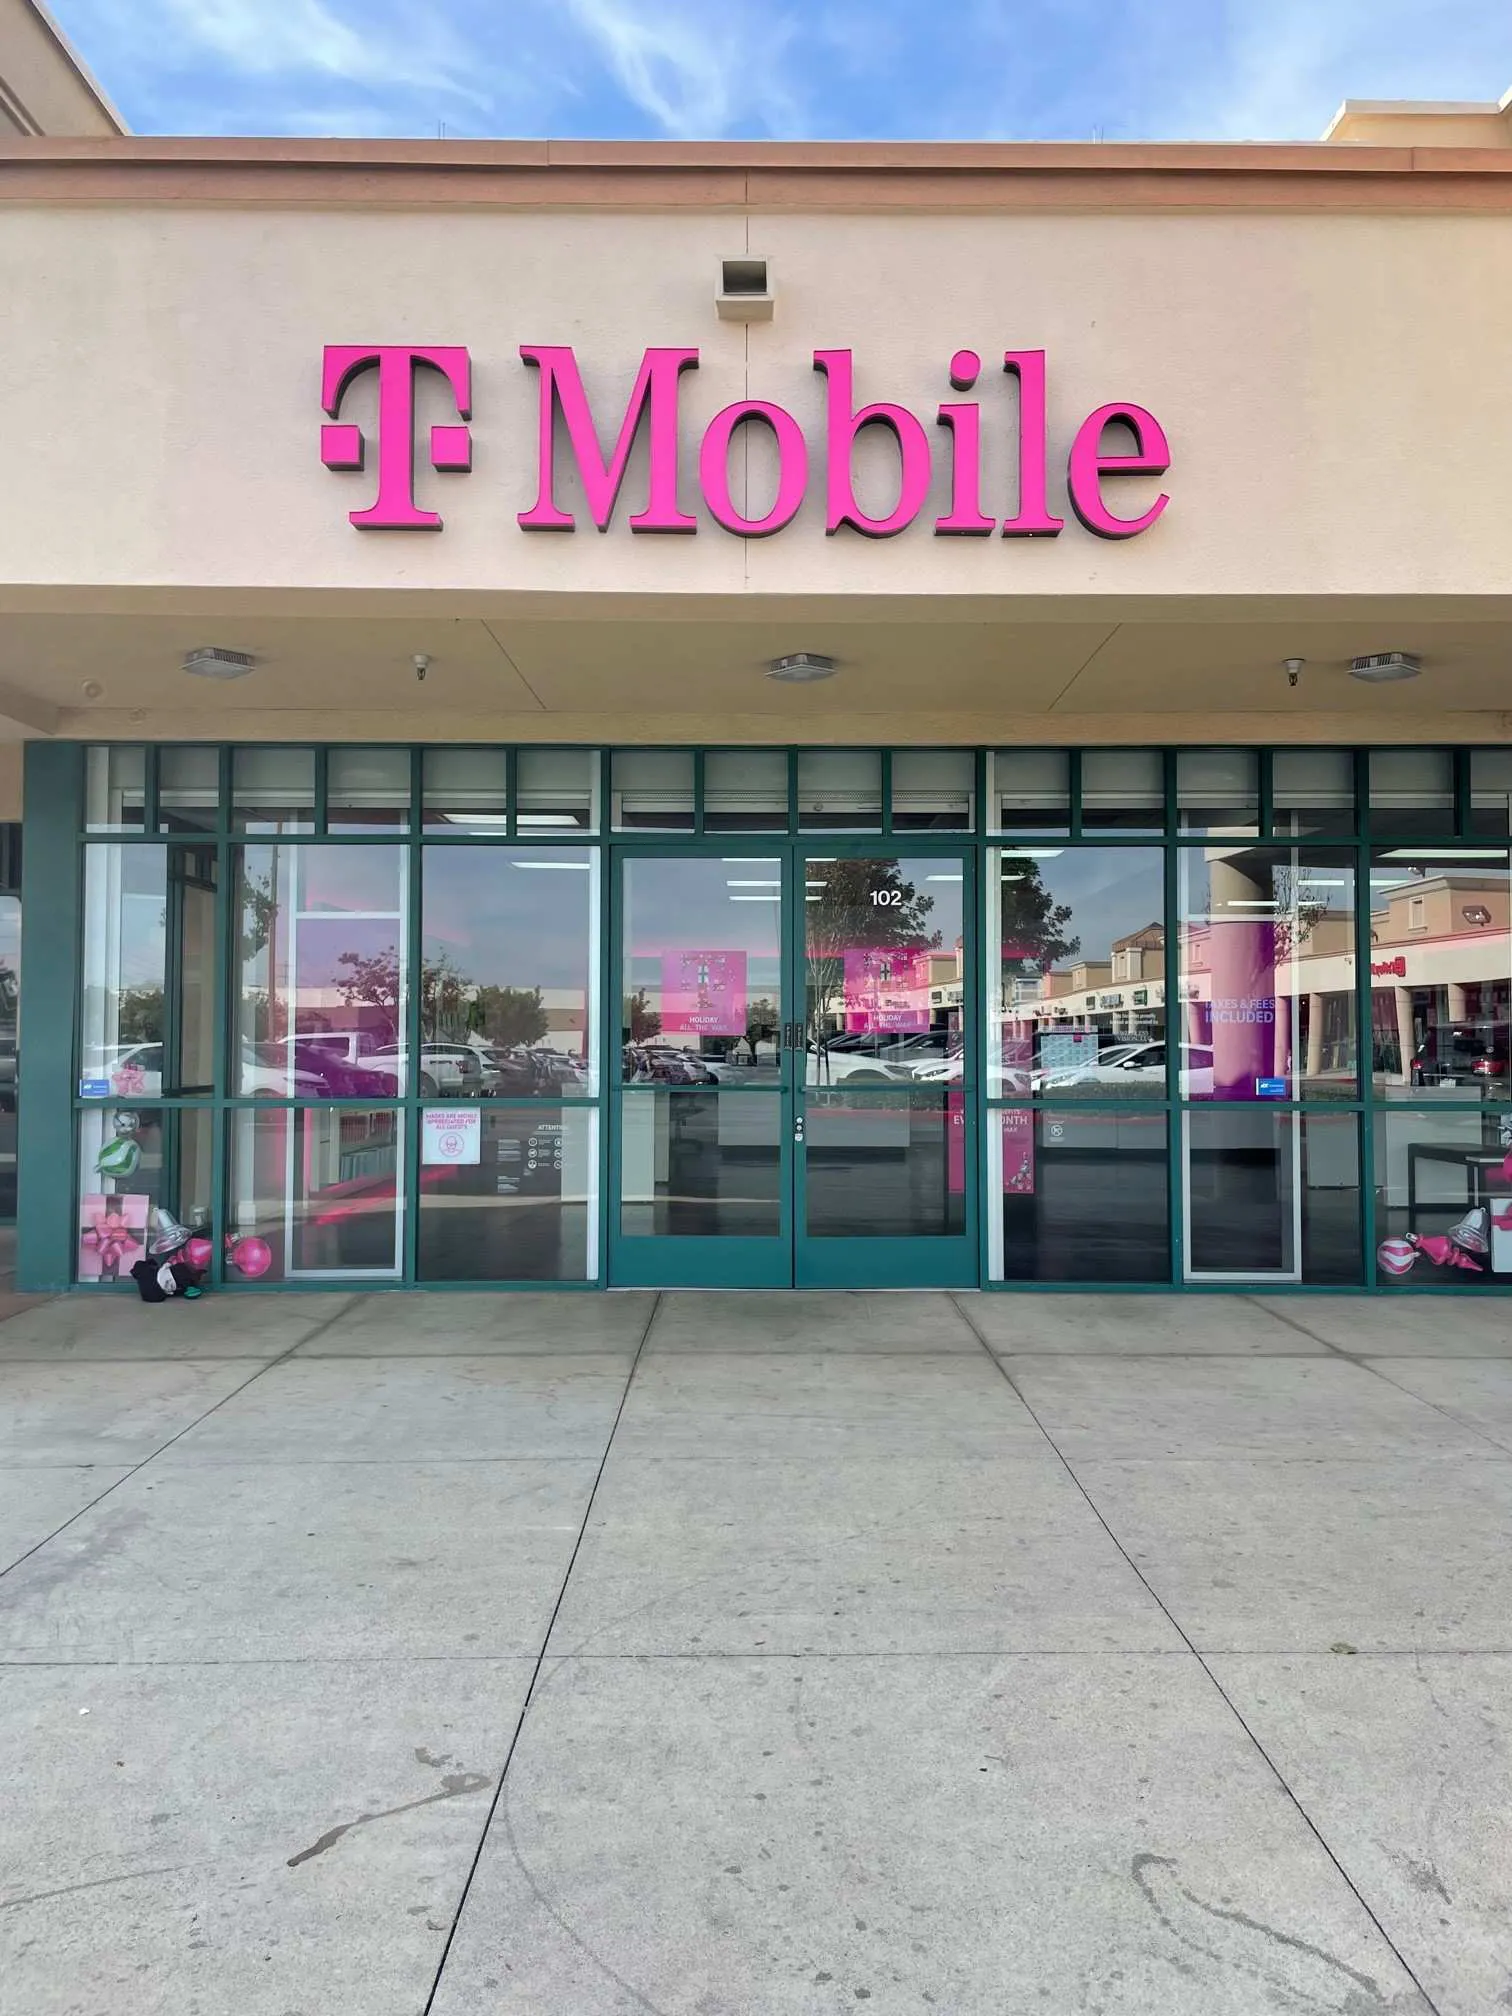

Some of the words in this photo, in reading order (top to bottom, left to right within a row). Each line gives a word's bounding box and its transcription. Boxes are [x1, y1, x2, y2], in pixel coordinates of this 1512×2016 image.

[517, 347, 1171, 540] Mobile
[869, 890, 902, 906] 102
[1205, 999, 1237, 1009] TAXES
[1239, 999, 1248, 1009] &
[1250, 999, 1275, 1009] FEES
[689, 1016, 719, 1024] HOLIDAY
[1205, 1010, 1274, 1023] INCLUDED
